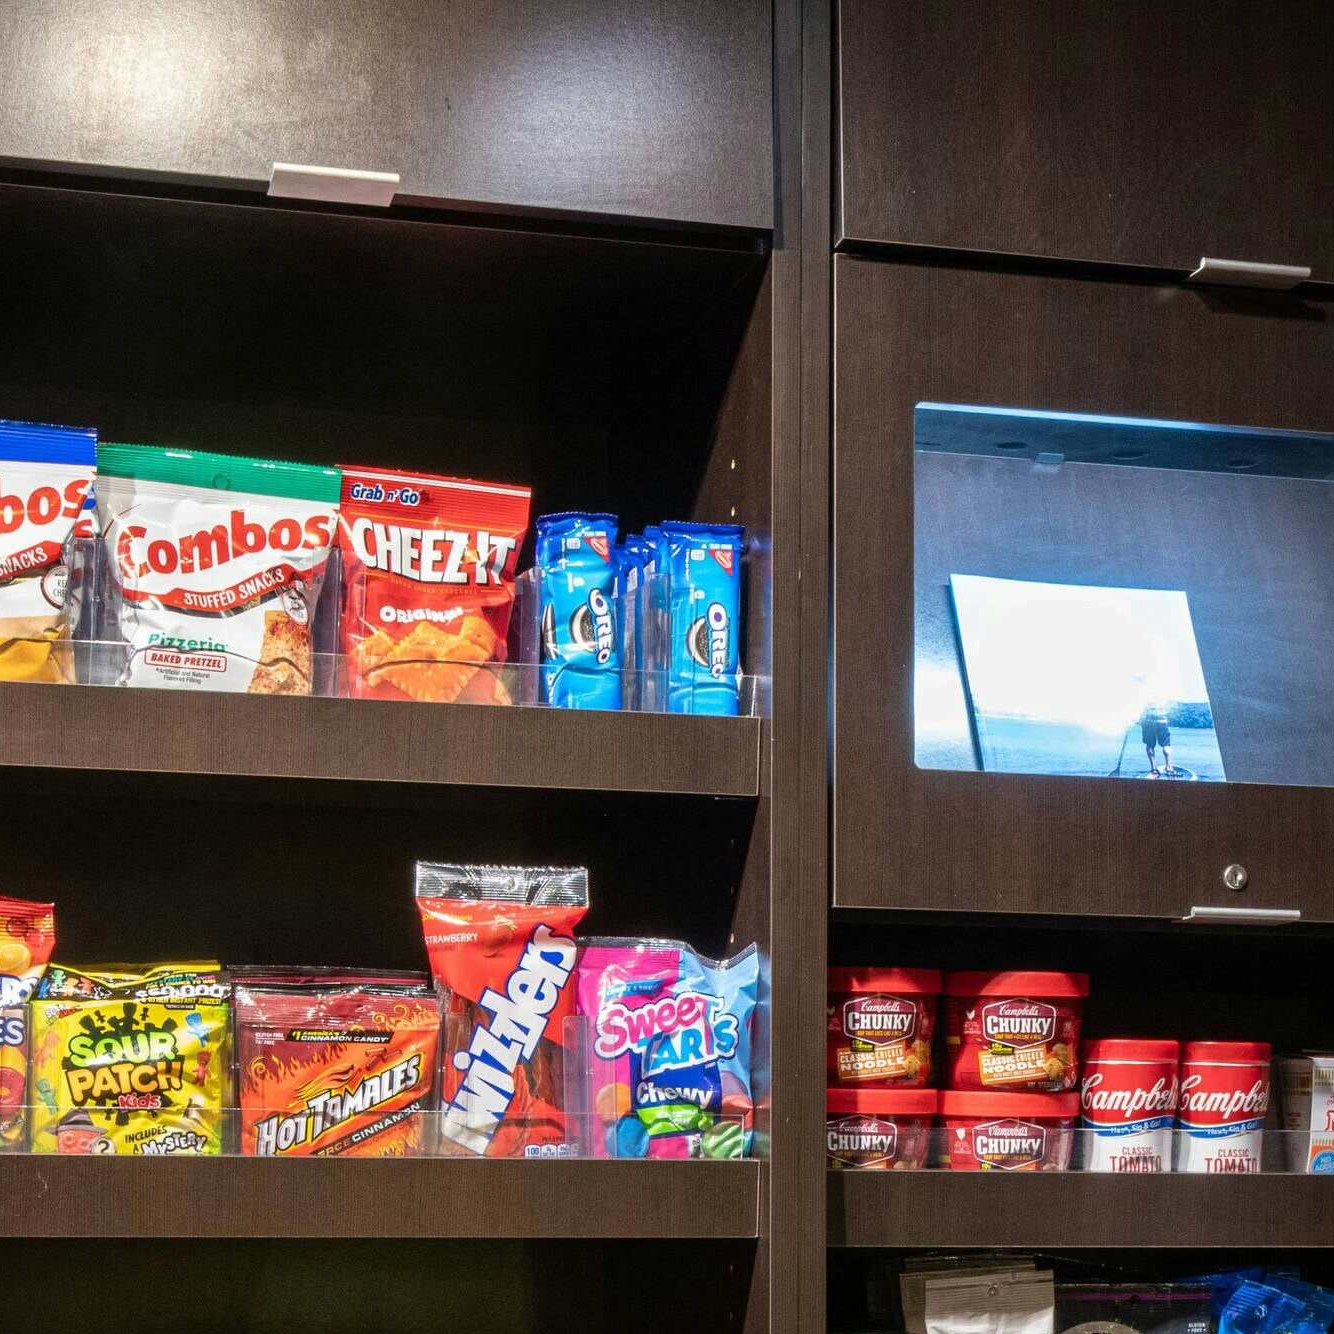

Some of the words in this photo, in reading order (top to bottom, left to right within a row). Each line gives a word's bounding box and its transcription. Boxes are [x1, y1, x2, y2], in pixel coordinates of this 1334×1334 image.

[351, 483, 383, 502] Grab
[399, 489, 419, 505] Go
[117, 510, 331, 578] Combos
[184, 588, 235, 608] STUFFED
[237, 568, 284, 600] SNACKS
[588, 588, 611, 665] OREO
[707, 602, 726, 678] OREO
[151, 652, 180, 665] BAKED
[184, 656, 222, 670] PRETZEL
[424, 933, 478, 945] STRAWBERRY
[848, 1012, 912, 1030] CHUNKY
[987, 1016, 1052, 1034] CHUNKY
[71, 1032, 177, 1068] SOUR
[841, 1058, 903, 1071] NOODLE
[983, 1060, 1044, 1073] NOODLE
[67, 1061, 182, 1103] PATCH
[118, 1094, 161, 1112] Kids
[256, 1115, 310, 1155] HOT
[308, 1053, 422, 1142] TAMALES
[636, 1082, 713, 1108] Chewy
[125, 1126, 167, 1143] INCLUDES
[827, 1132, 891, 1151] CHUNKY
[977, 1138, 1041, 1154] CHUNKY
[1122, 1147, 1153, 1155] CLASSIC
[1218, 1149, 1249, 1157] CLASSIC
[1110, 1156, 1162, 1172] TOMATO
[1205, 1158, 1257, 1173] TOMATO
